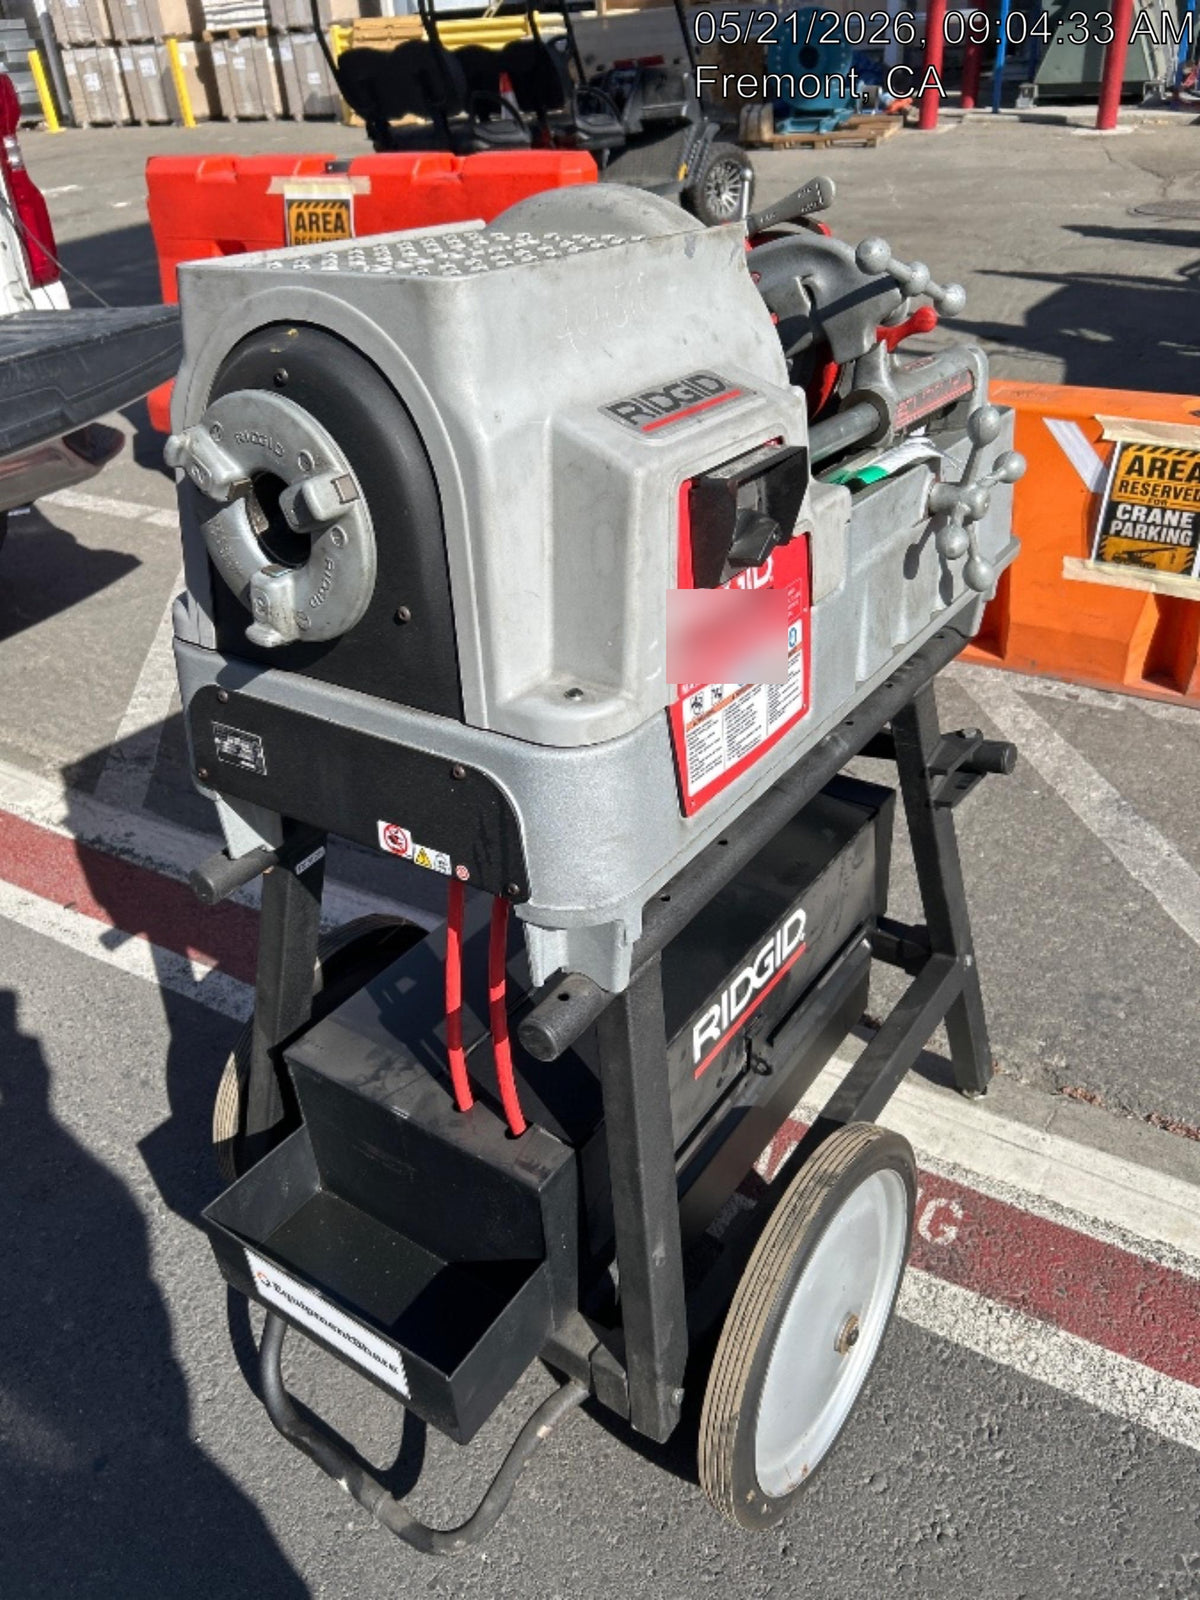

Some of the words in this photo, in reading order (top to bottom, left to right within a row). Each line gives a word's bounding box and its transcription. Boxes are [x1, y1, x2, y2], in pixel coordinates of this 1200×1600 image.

[295, 211, 346, 233] AREA
[606, 374, 726, 425] RIDGID
[1116, 503, 1196, 529] CRANE
[1109, 520, 1194, 546] PARKING
[693, 908, 806, 1064] RIDGID
